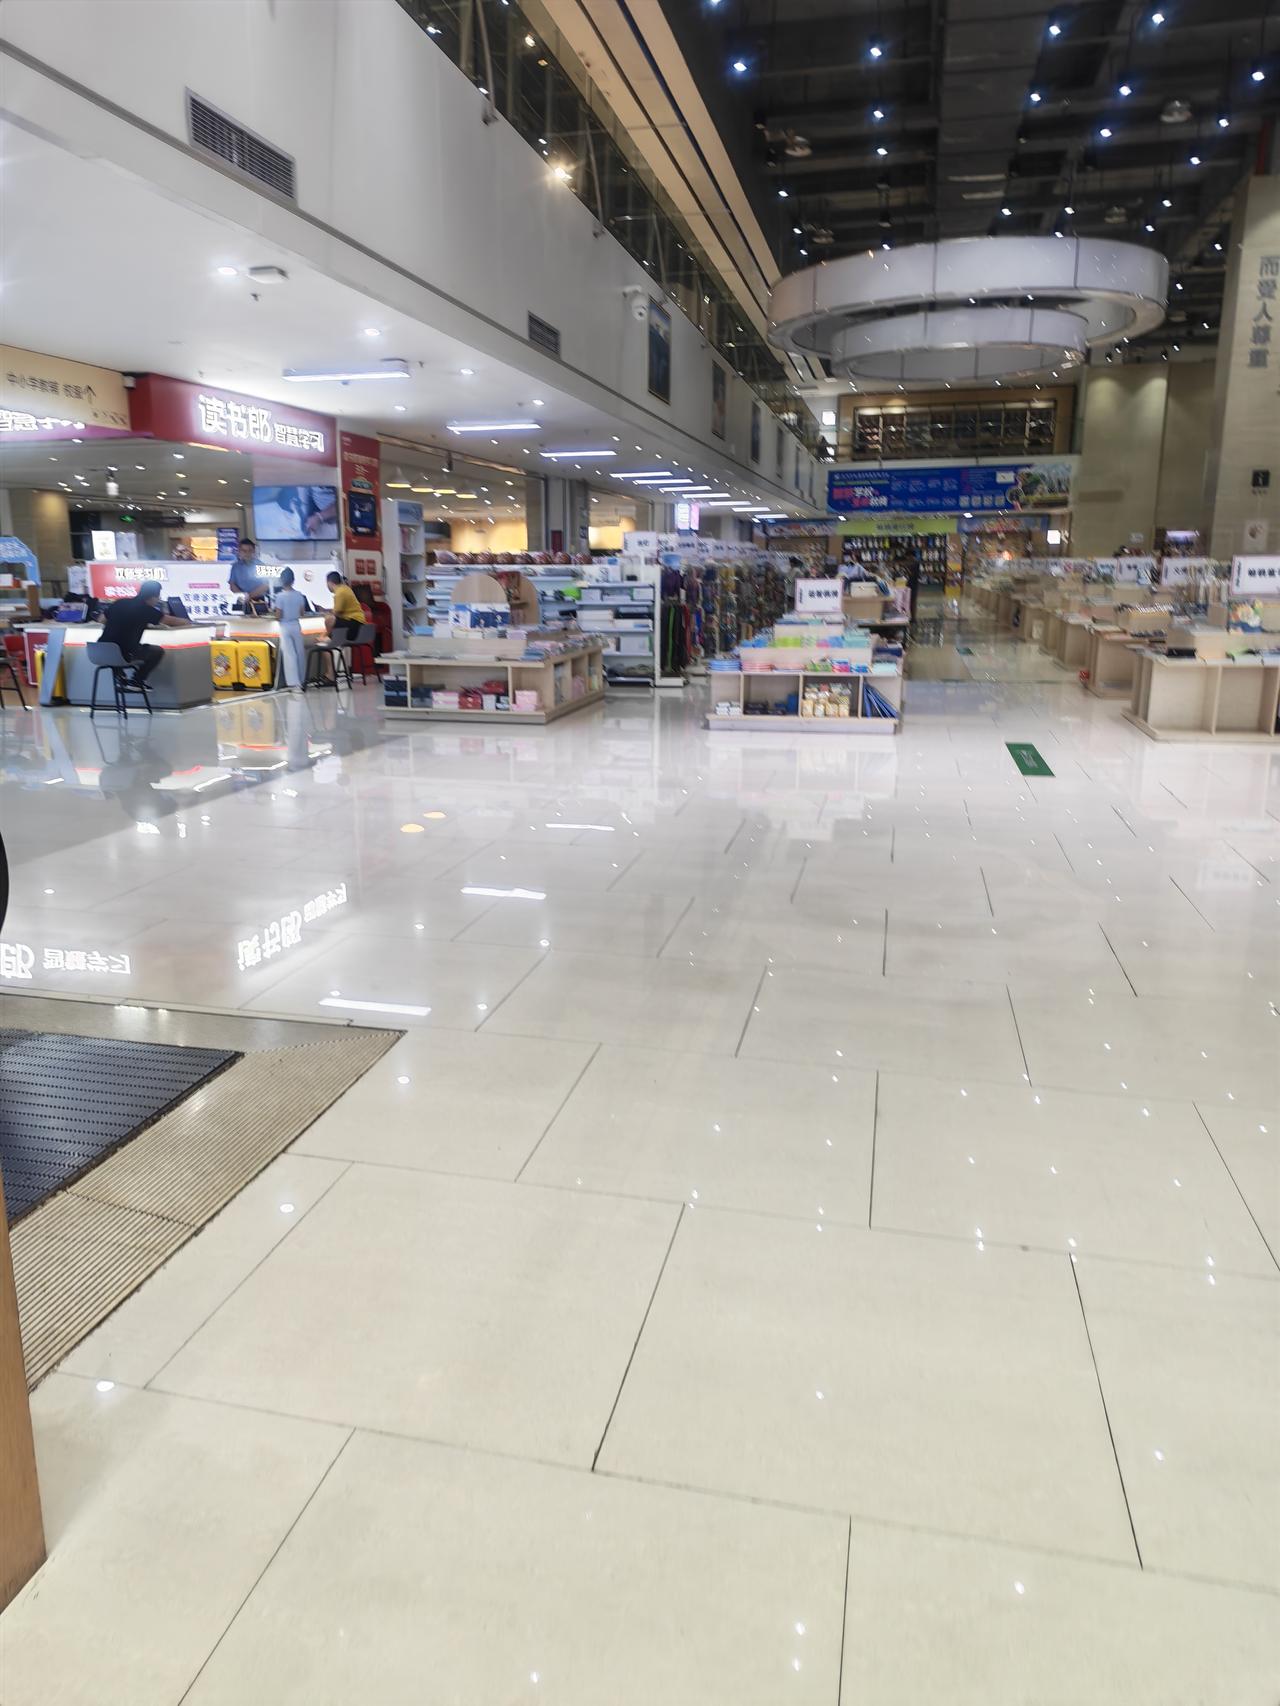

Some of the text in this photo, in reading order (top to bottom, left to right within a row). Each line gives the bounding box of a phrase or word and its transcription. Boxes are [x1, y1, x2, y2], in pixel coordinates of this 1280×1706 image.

[198, 394, 325, 452] 读书郎 智慧学习
